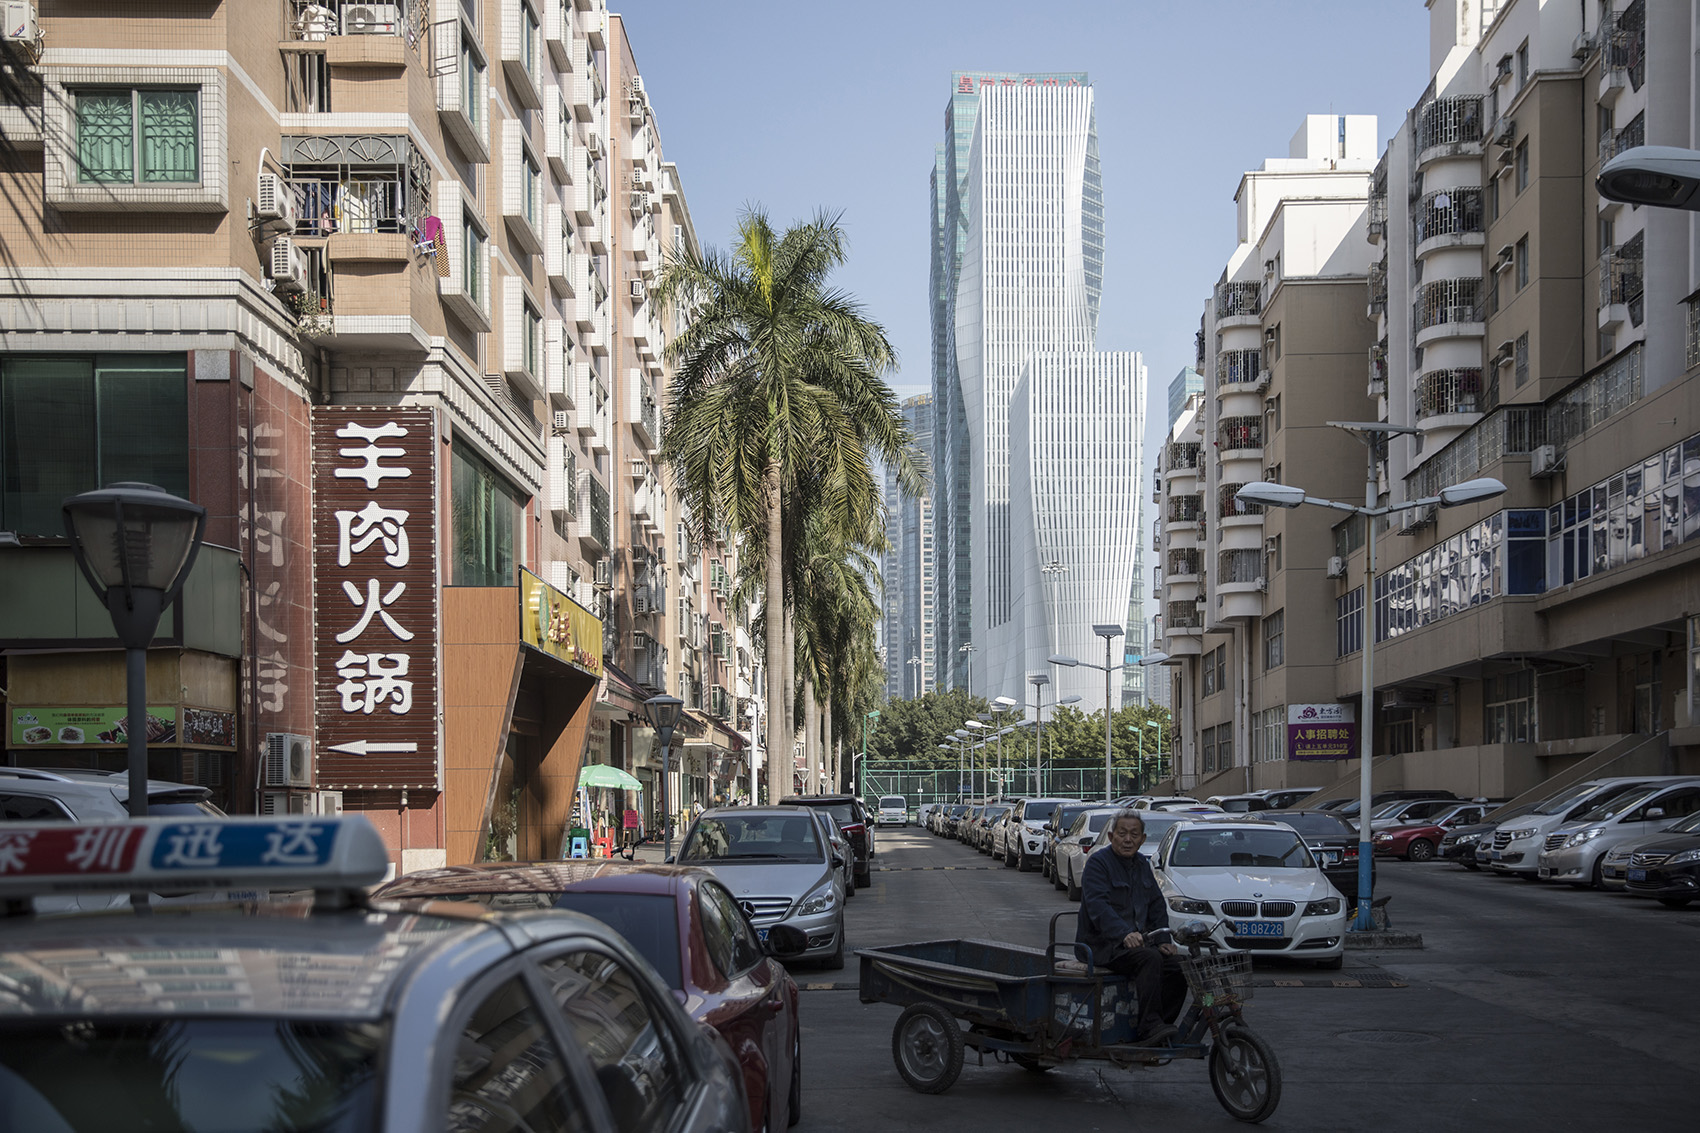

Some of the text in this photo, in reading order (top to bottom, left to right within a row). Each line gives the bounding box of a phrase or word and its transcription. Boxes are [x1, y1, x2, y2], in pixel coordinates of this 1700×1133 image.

[334, 420, 416, 716] 羊肉火锅
[1294, 728, 1349, 740] 人事招聘处
[0, 822, 324, 872] 深圳 迅达
